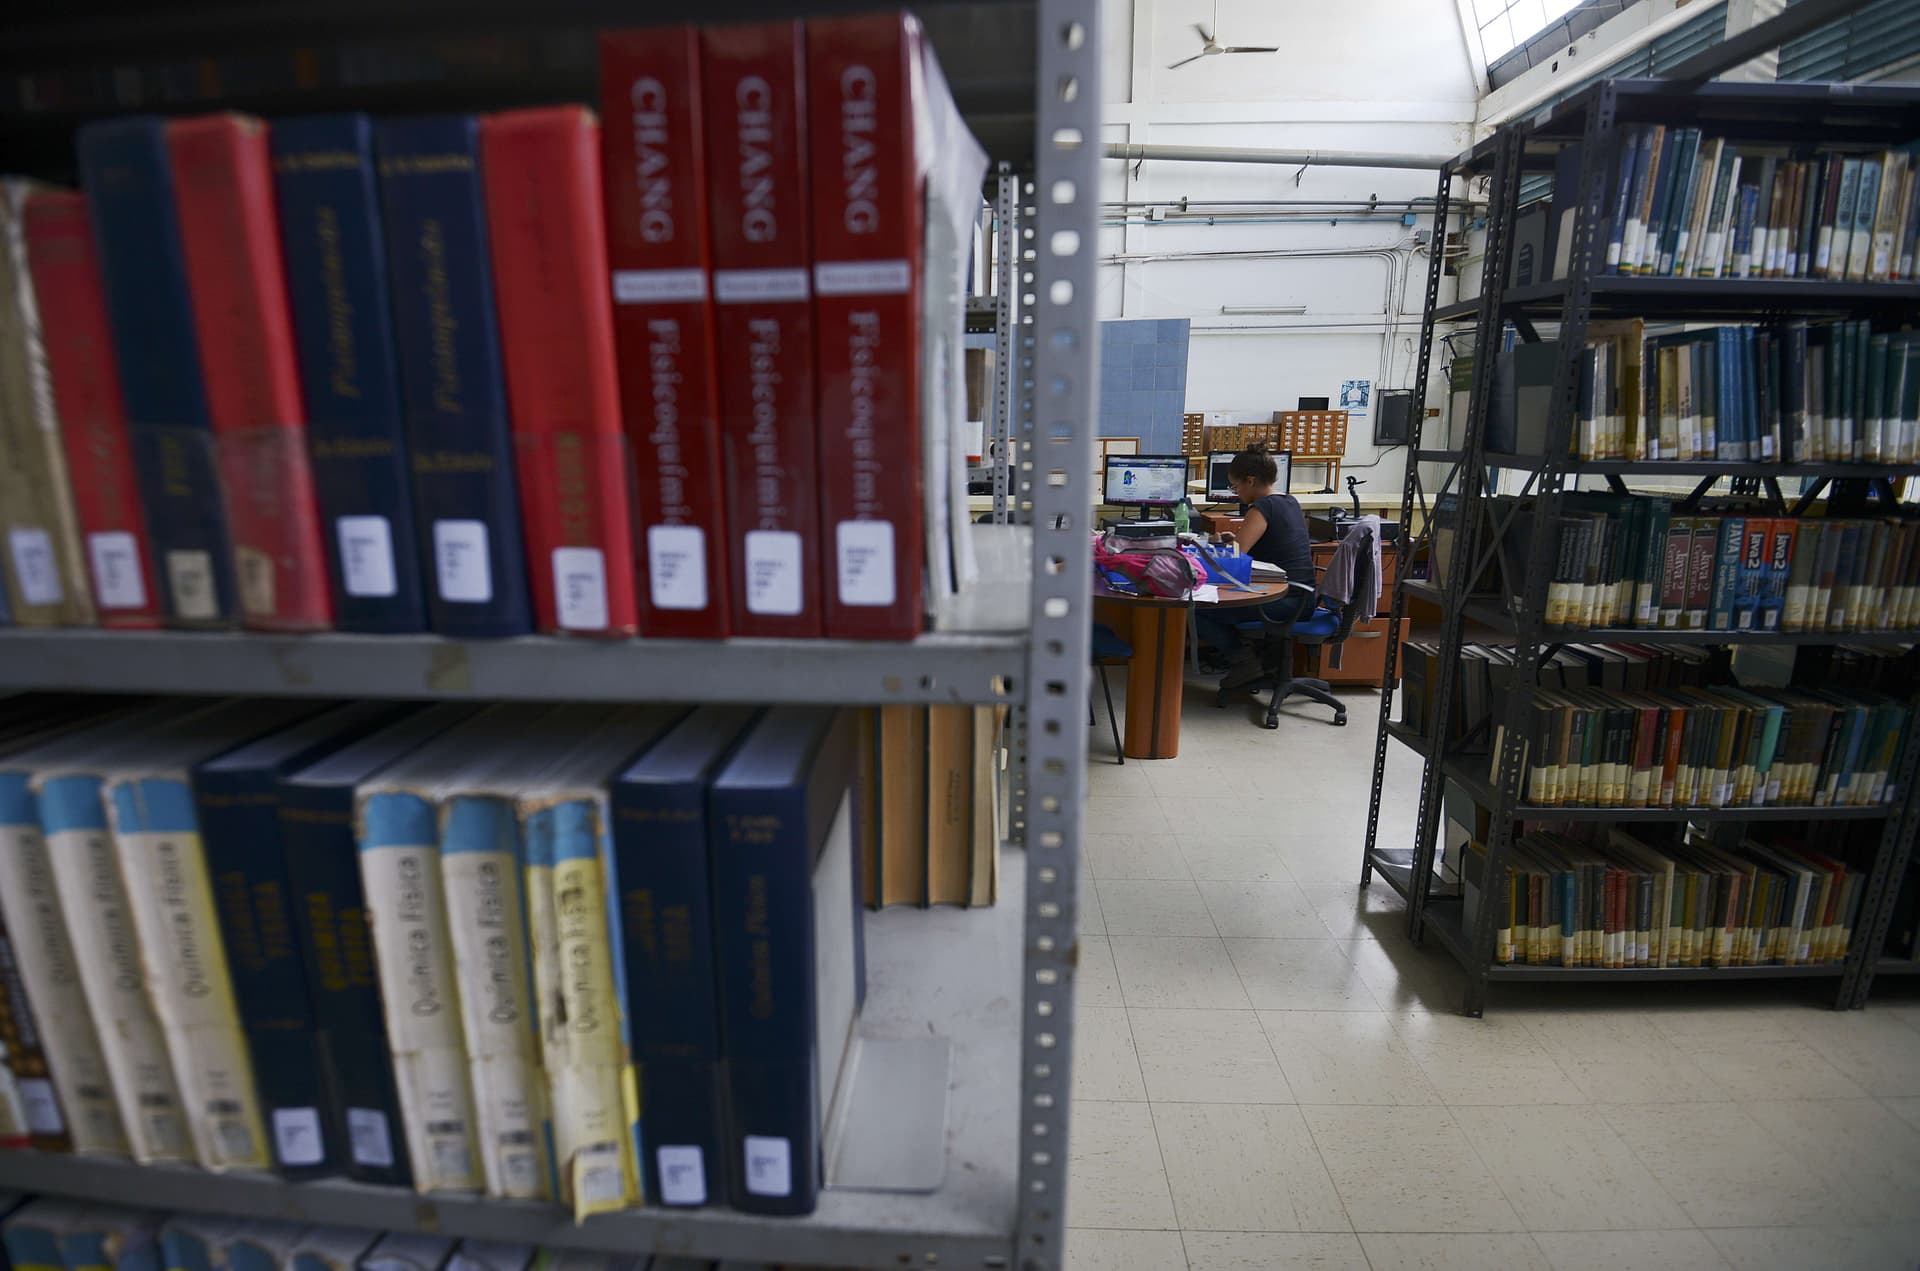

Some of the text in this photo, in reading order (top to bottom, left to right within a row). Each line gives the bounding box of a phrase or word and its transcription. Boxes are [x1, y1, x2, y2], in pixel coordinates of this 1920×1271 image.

[631, 77, 673, 243] CHANG
[735, 75, 777, 242] CHANG
[839, 64, 879, 234] CHANG
[648, 319, 690, 527] Fisicoquímic
[748, 319, 786, 531] Fisicoquímic
[847, 312, 882, 522] Fisicoquími
[1728, 523, 1743, 554] JAVA
[1749, 533, 1764, 558] Java
[1775, 534, 1790, 559] Java
[1674, 550, 1688, 579] Java
[1699, 550, 1713, 580] Java
[1748, 559, 1759, 569] 2
[1774, 559, 1786, 570] 2
